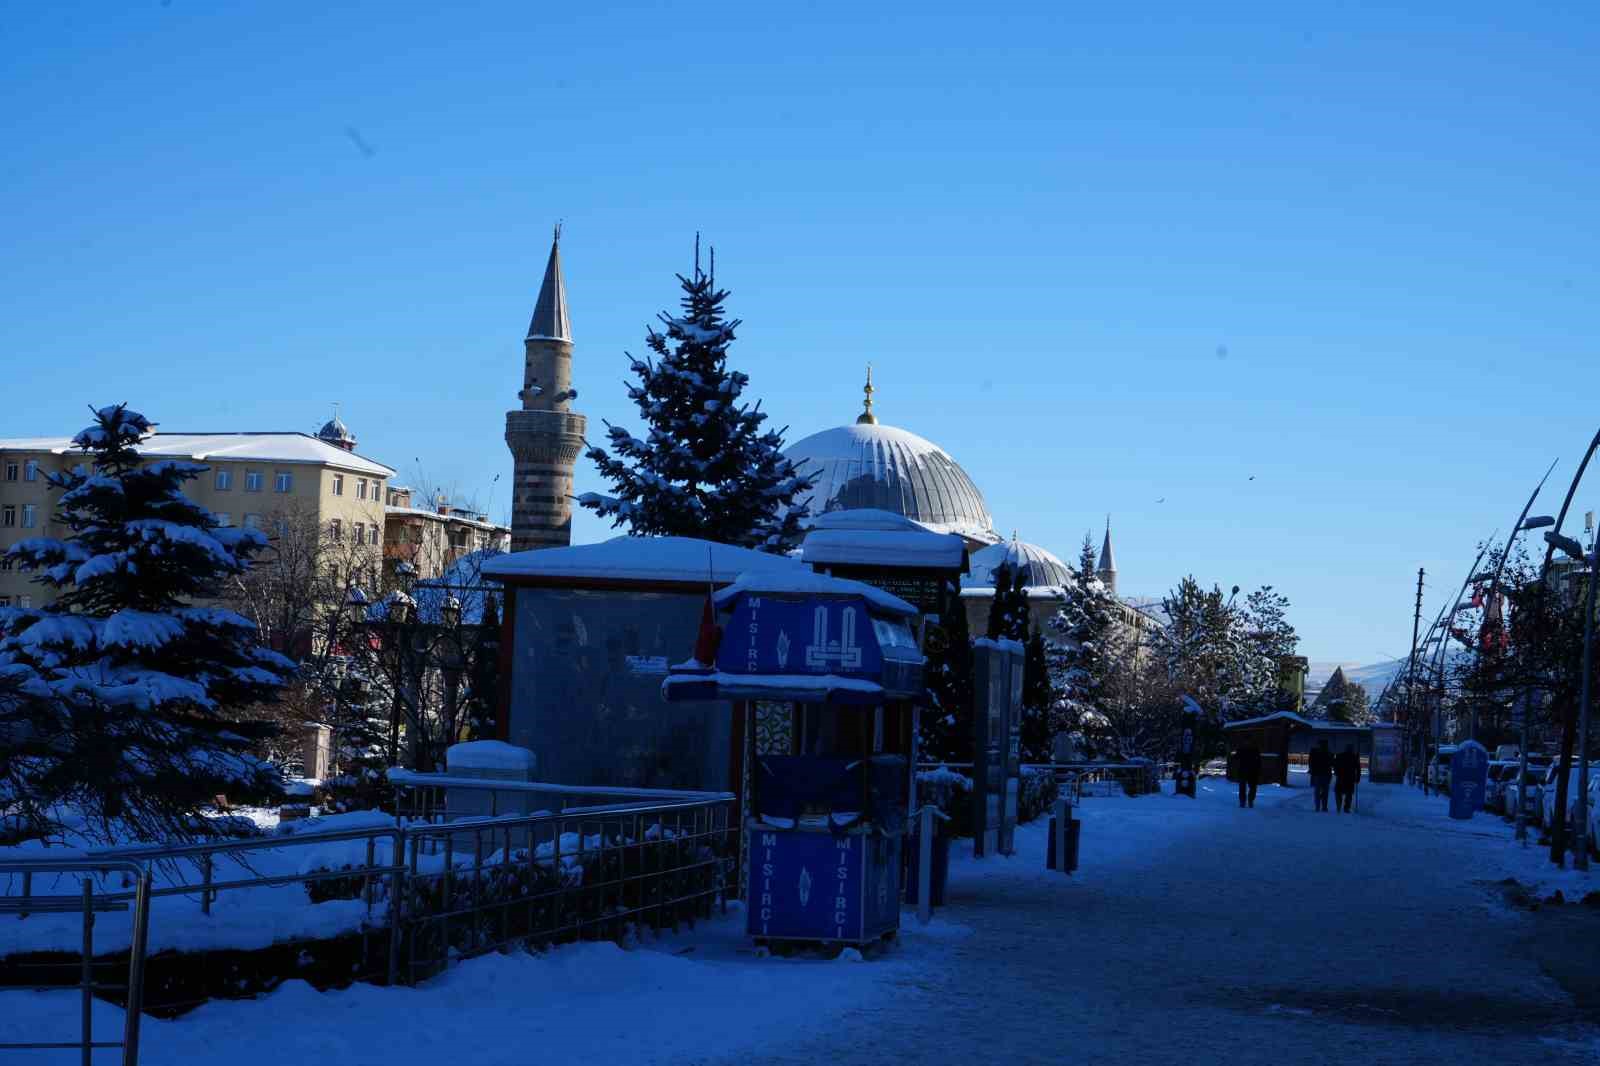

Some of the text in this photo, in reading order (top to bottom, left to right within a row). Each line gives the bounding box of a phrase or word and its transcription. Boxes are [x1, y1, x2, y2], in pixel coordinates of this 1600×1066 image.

[747, 597, 761, 672] MISIRC
[761, 833, 777, 935] MISIRCI
[834, 836, 852, 938] MISIRCI
